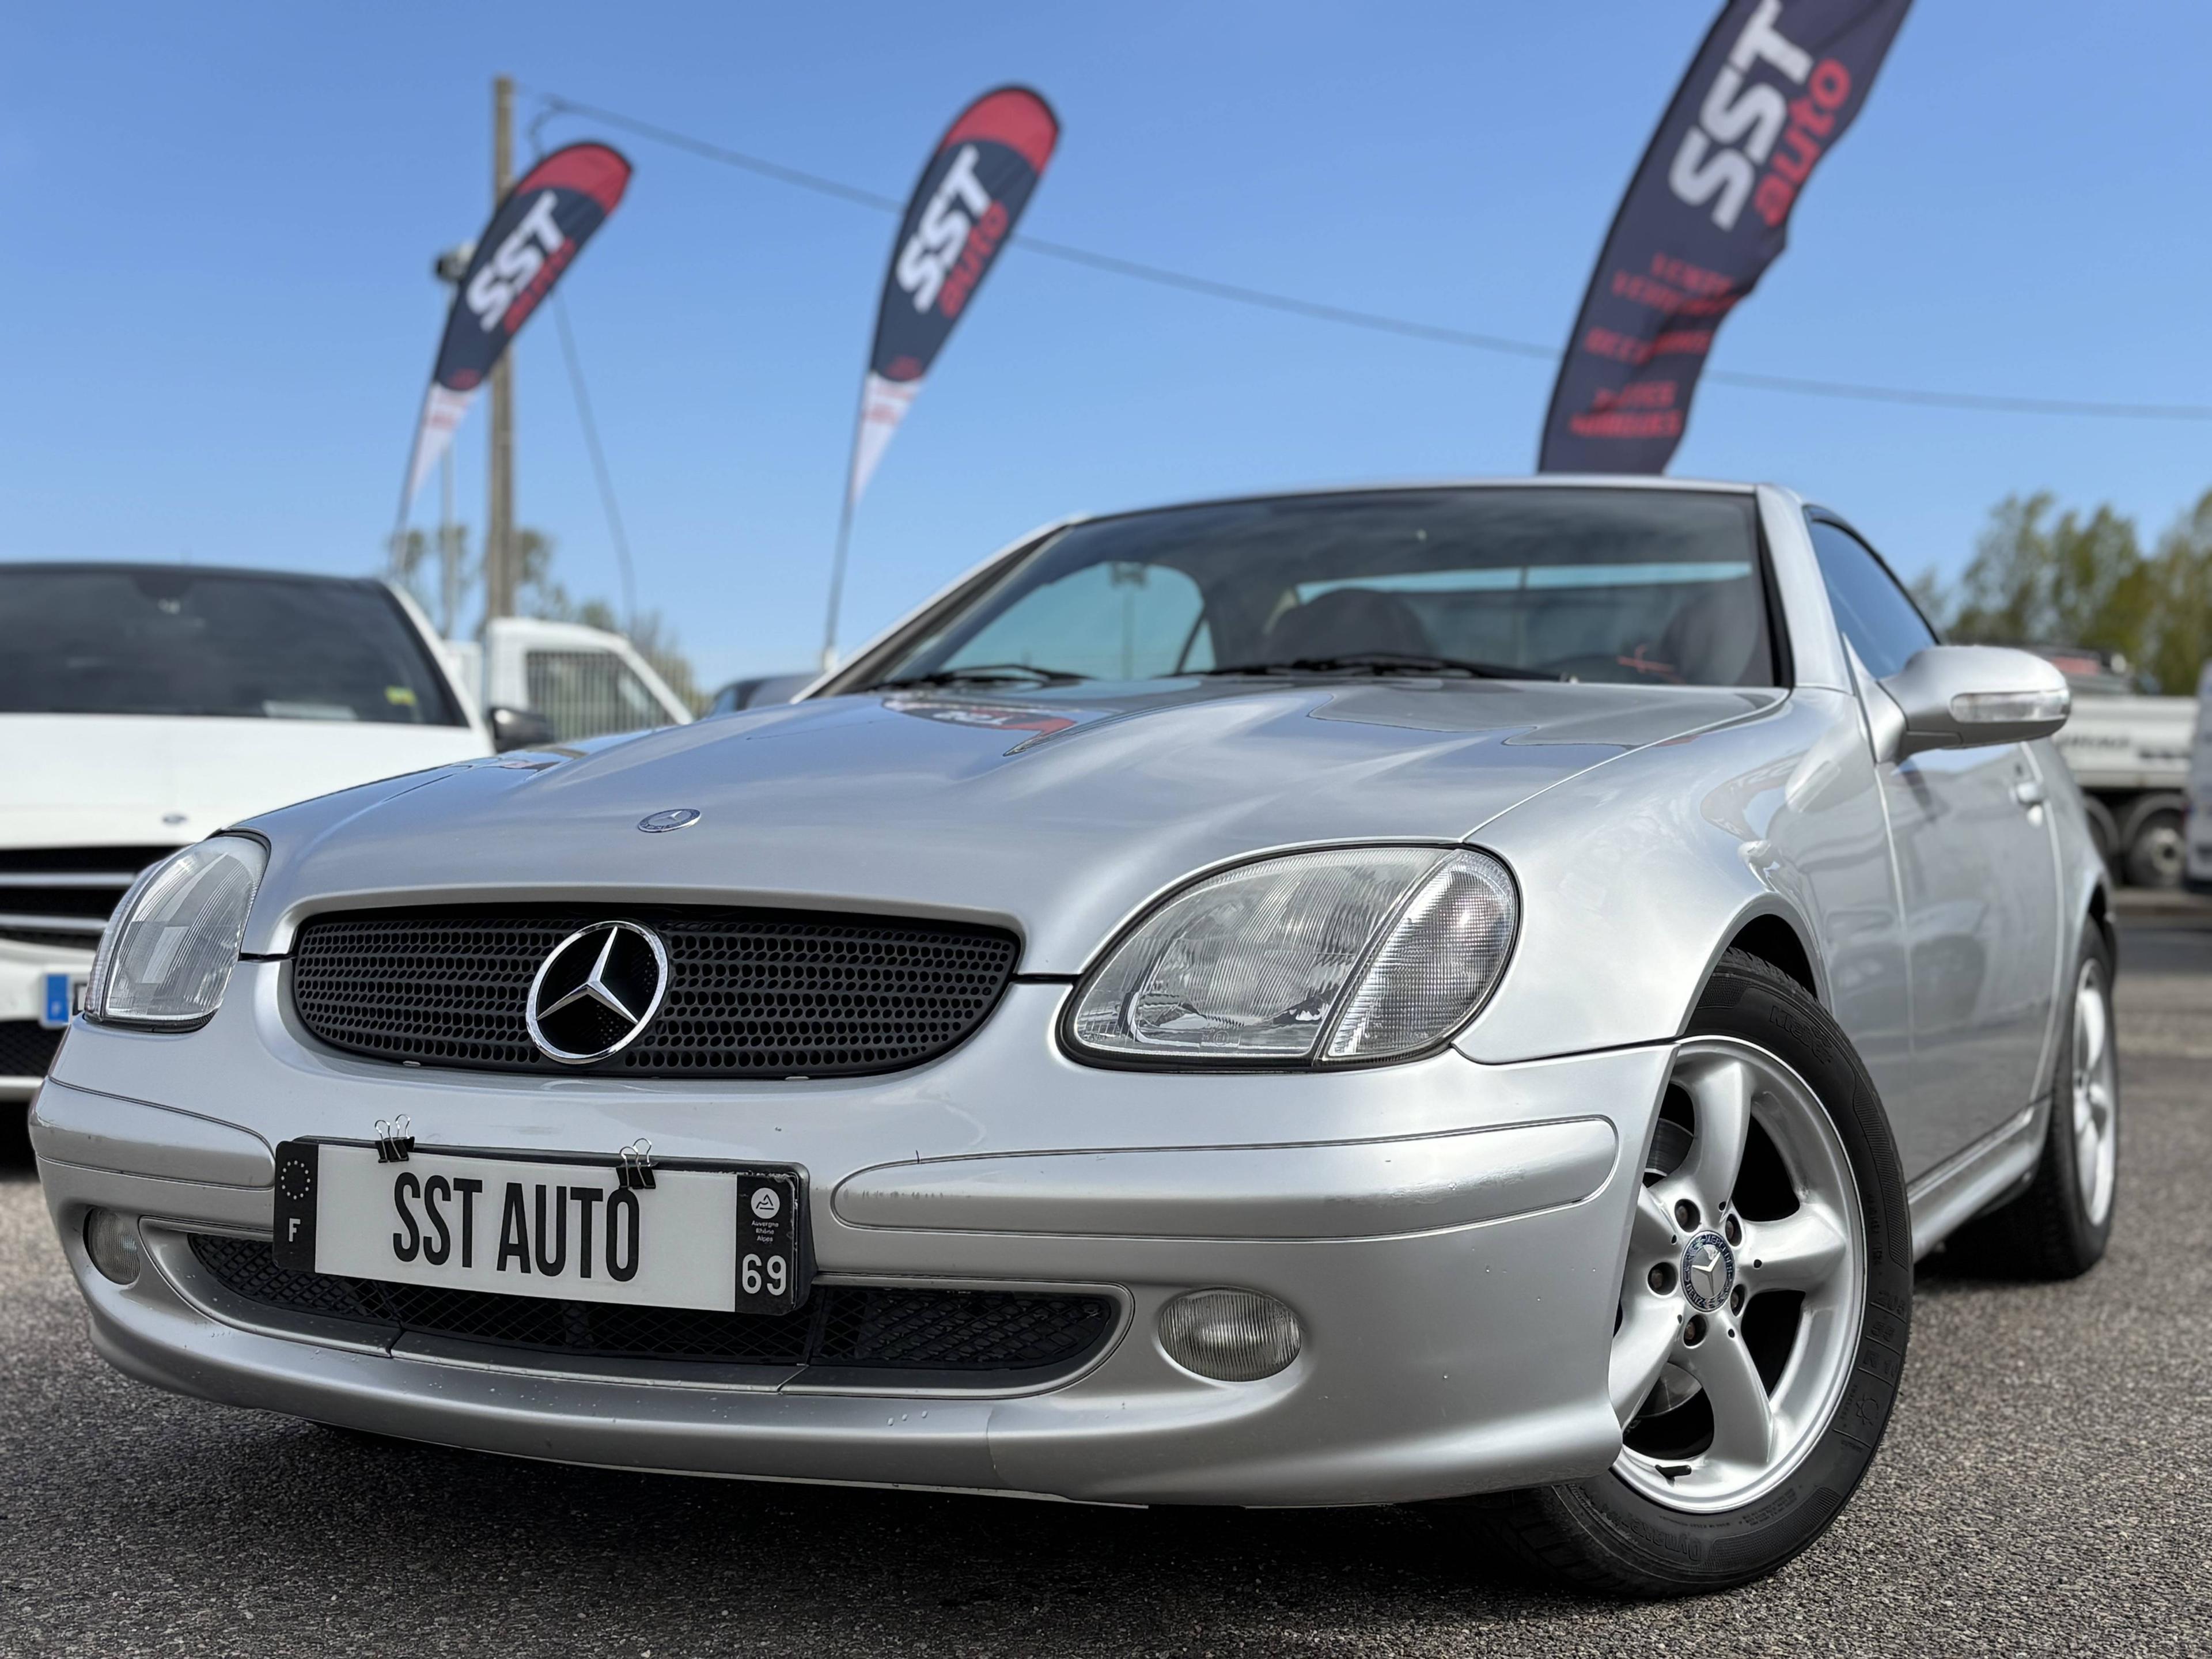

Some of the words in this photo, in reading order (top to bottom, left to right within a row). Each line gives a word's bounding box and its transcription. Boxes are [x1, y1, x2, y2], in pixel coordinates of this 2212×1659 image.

[1669, 0, 1815, 231] SST
[1754, 59, 1851, 227] auto
[465, 189, 565, 333] SST
[895, 143, 992, 314] SST
[289, 1218, 301, 1242] F
[393, 1172, 482, 1268] SST
[497, 1181, 641, 1282] AUTO
[742, 1253, 787, 1296] 69
